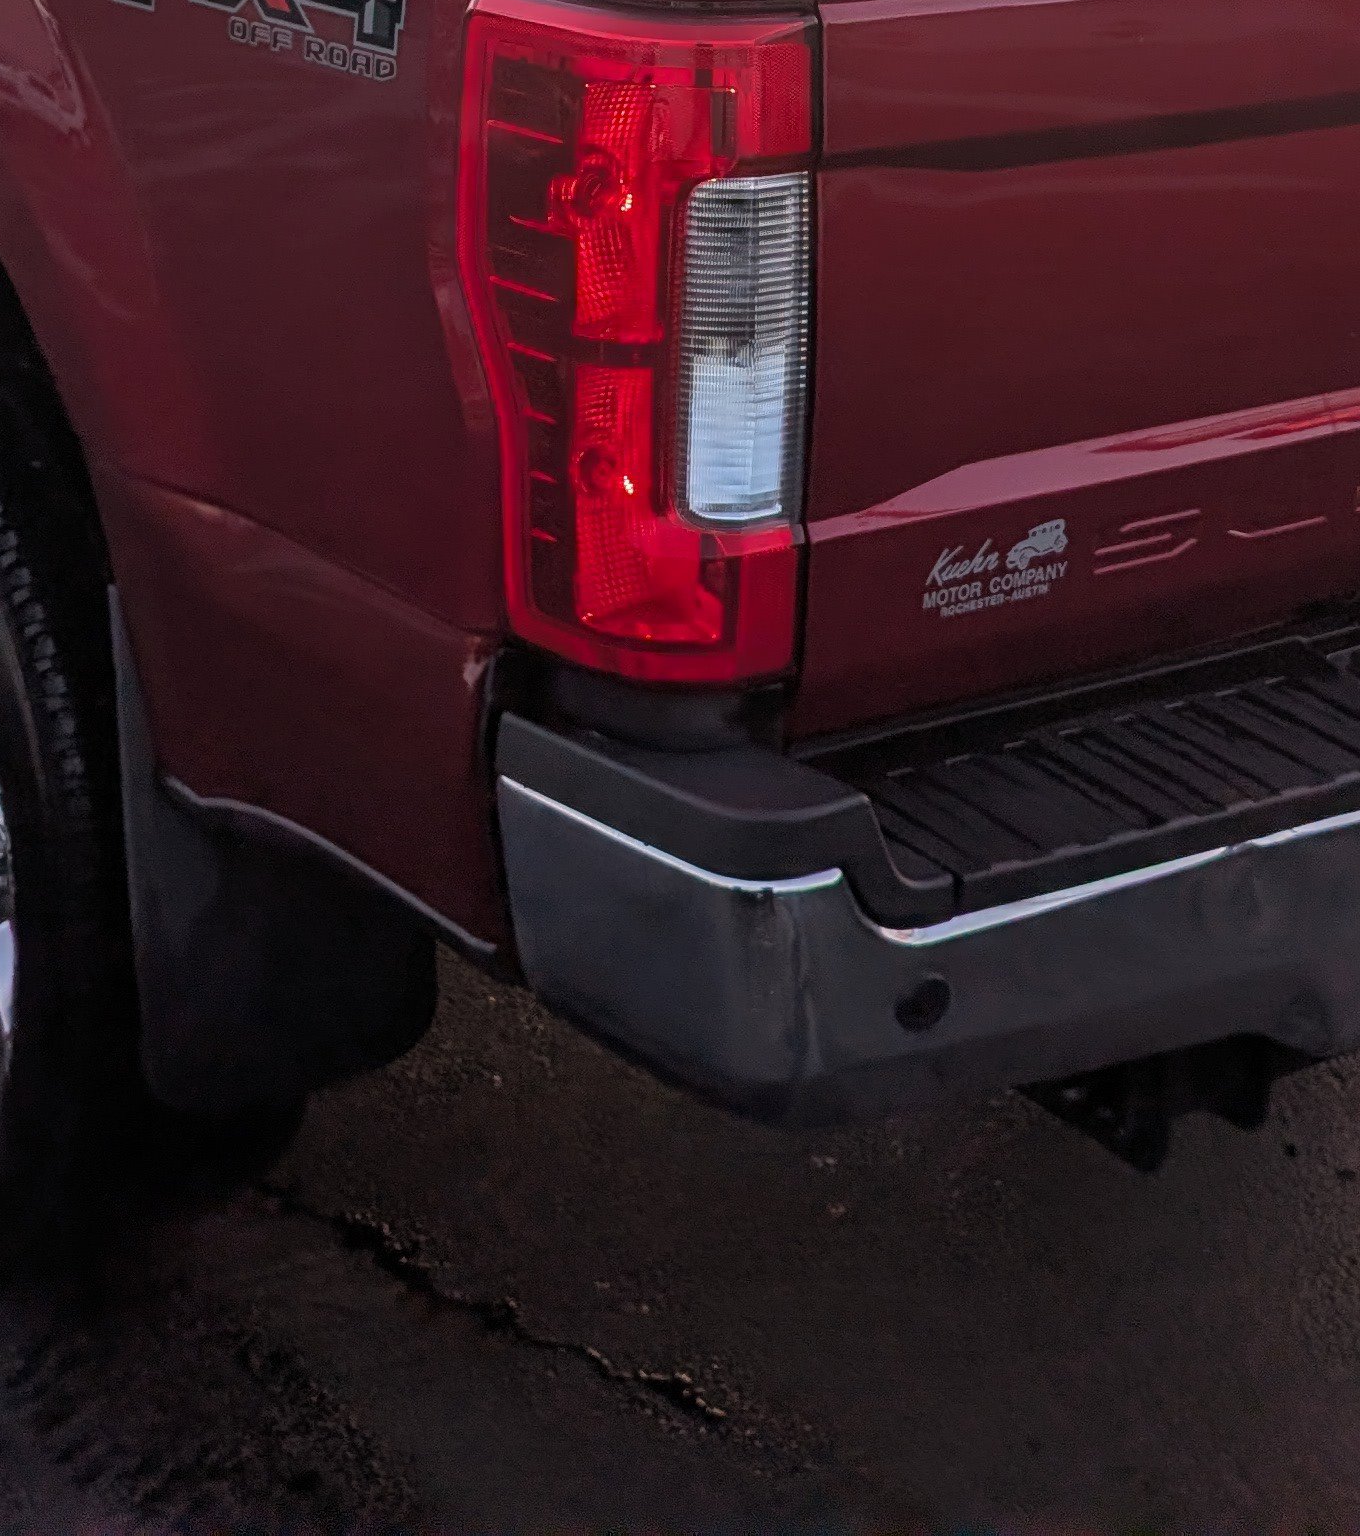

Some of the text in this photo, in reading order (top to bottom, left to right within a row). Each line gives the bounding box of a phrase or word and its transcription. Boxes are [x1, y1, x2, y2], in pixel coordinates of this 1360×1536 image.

[228, 16, 397, 81] OFF ROAD
[923, 561, 1068, 608] MOTOR COMPANY
[925, 538, 1000, 586] Kuehn
